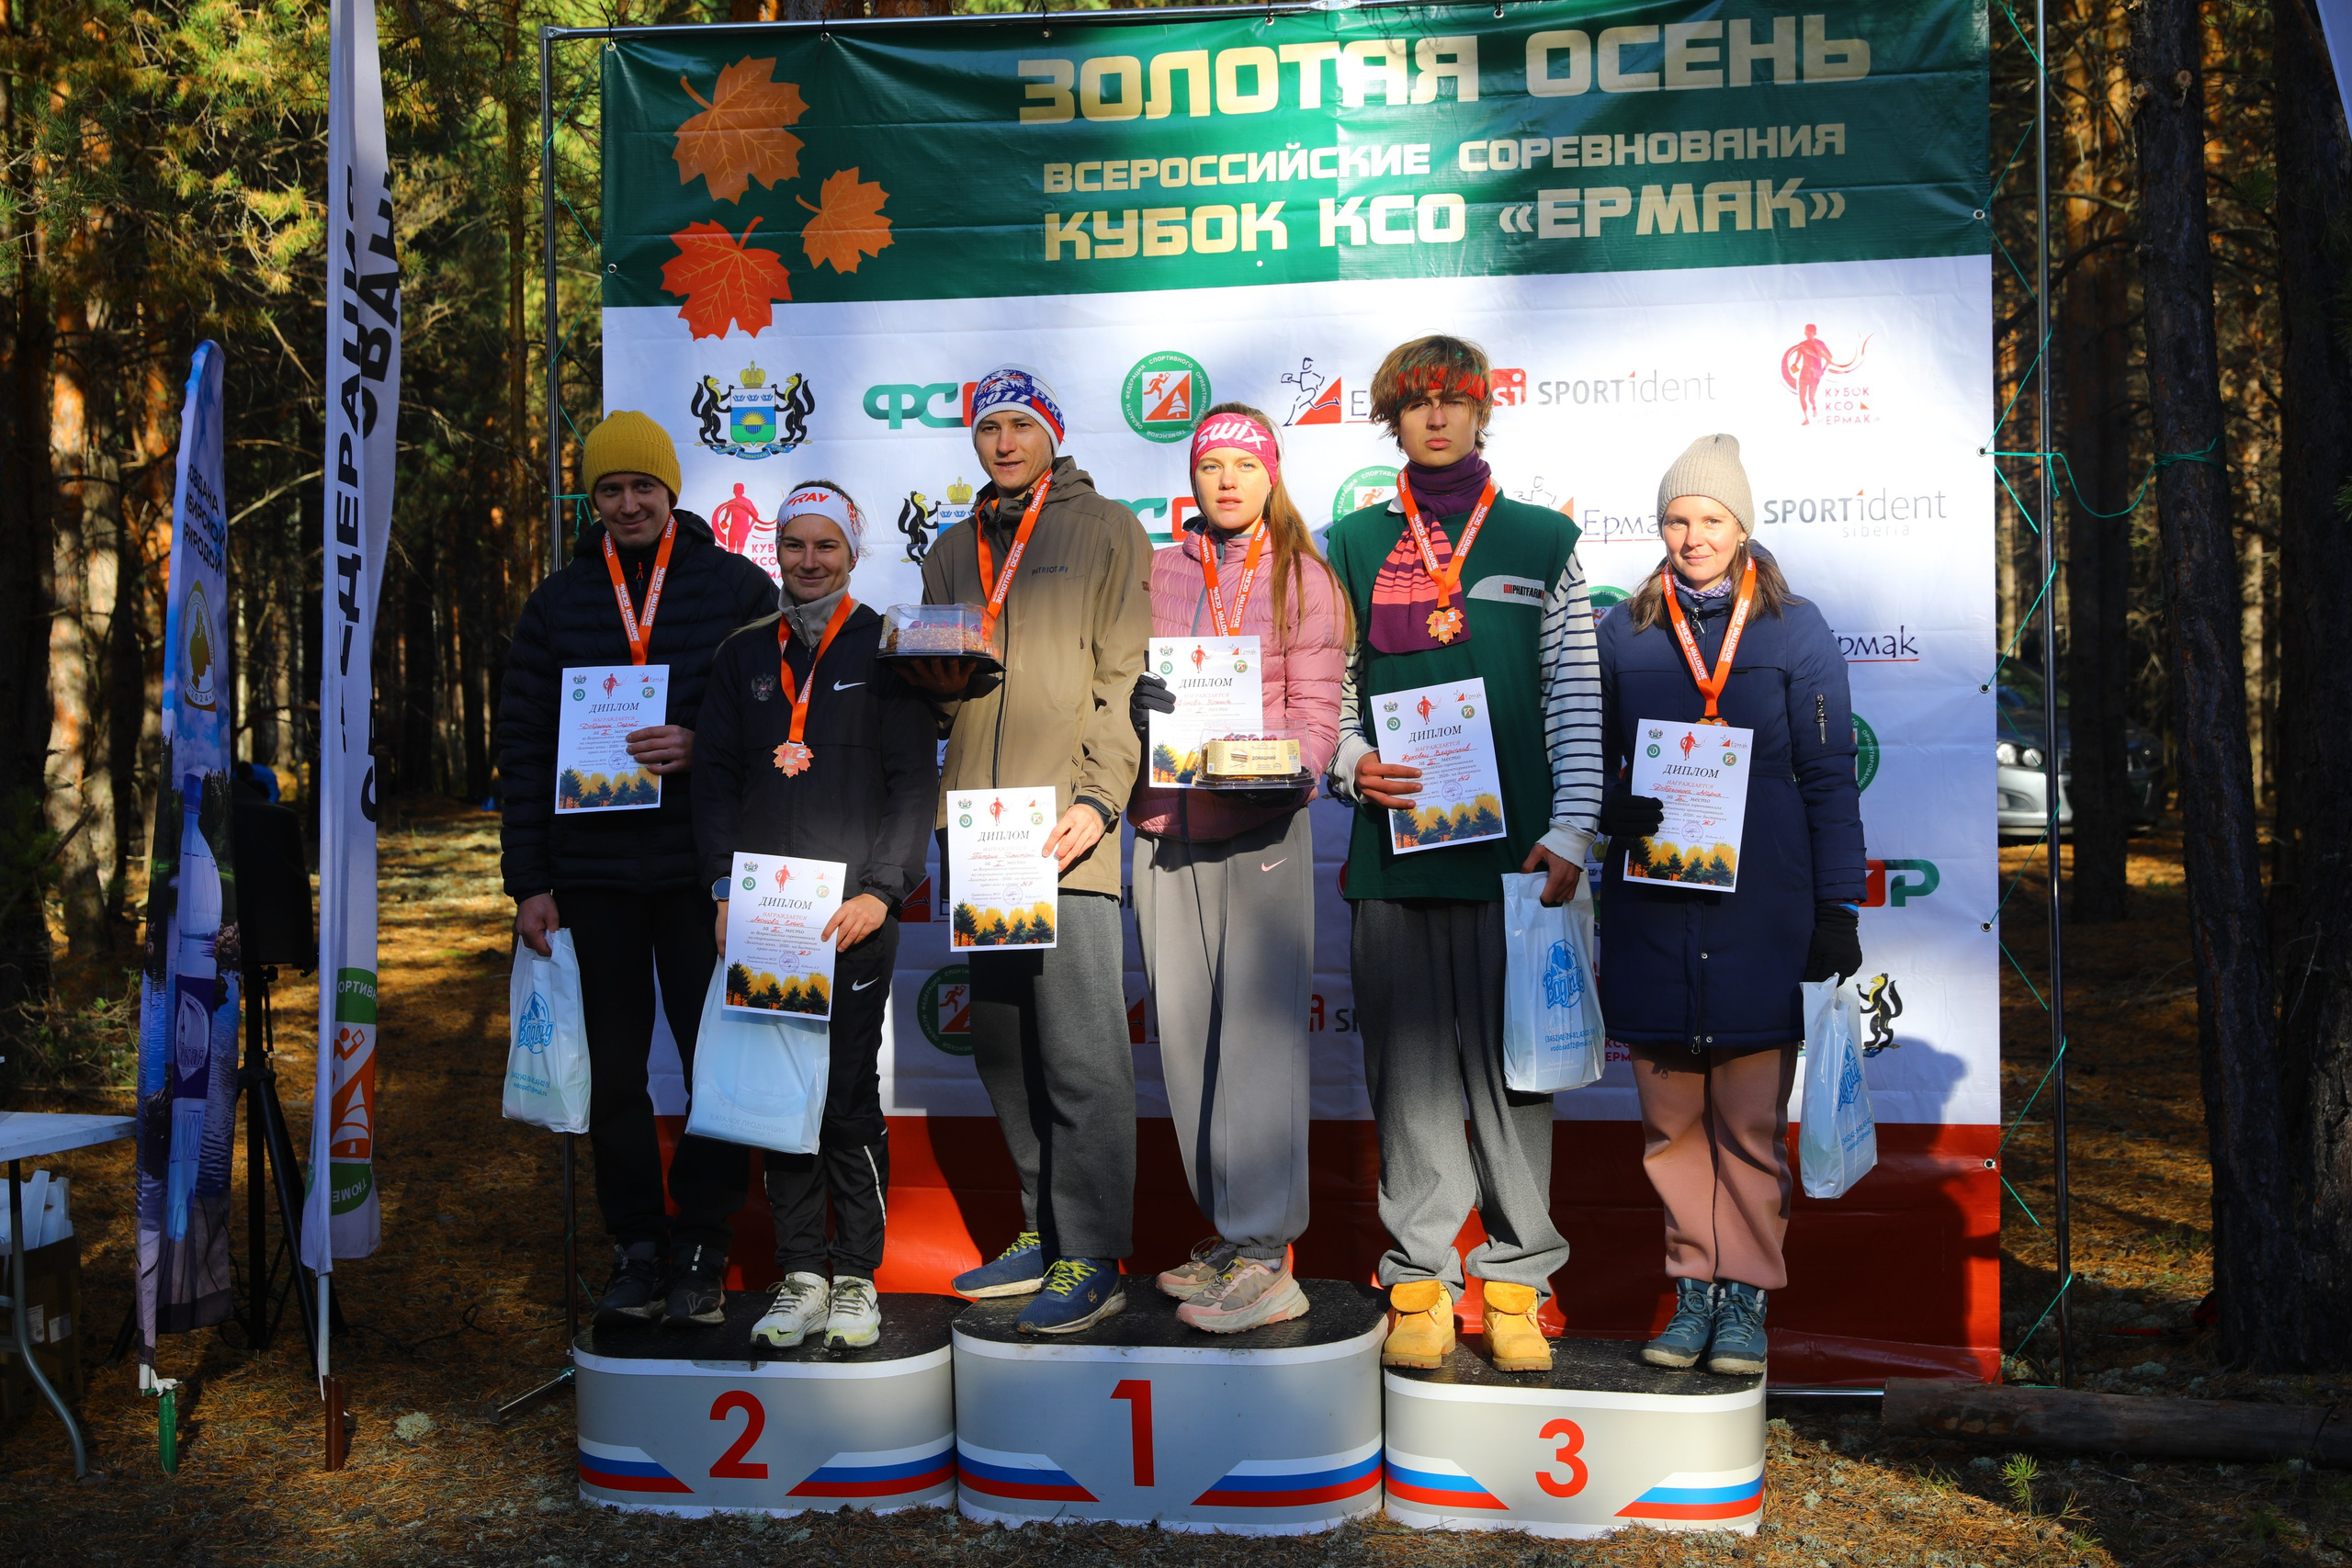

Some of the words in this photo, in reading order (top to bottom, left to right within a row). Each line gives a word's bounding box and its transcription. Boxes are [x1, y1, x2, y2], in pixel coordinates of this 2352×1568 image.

[1018, 35, 1479, 125] ЗОЛОТАЯ
[1525, 14, 1871, 97] ОСЕНЬ
[1044, 142, 1430, 193] ВСЕРОССИЙСКИЕ
[1458, 123, 1846, 172] СОРЕВНОВАНИЯ
[1045, 200, 1287, 261] КУБОК
[1318, 193, 1465, 247] КСО
[1498, 177, 1846, 240] «ЕРМАК»
[1148, 355, 1193, 368] СПОРТИВНОГО
[1125, 364, 1146, 400] ФЕДЕРАЦИЯ
[1537, 369, 1716, 406] SPORTident
[1825, 387, 1870, 398] КУБОК
[1125, 402, 1143, 430] ОБЛАСТИ
[1825, 400, 1854, 412] КСО
[1146, 430, 1186, 439] ТЮМЕНСКОЙ
[1029, 483, 1047, 513] ТЮМЕНЬ
[1338, 479, 1358, 514] ФЕДЕРАЦИЯ
[1764, 488, 1947, 525] SPORTident
[1415, 513, 1426, 537] ОСЕНЬ
[1460, 527, 1477, 557] ЗОЛОТАЯ
[1475, 506, 1487, 526] ОСЕНЬ
[1842, 524, 1910, 538] siberia
[1422, 536, 1439, 570] ЗОЛОТАЯ
[996, 569, 1013, 604] ЗОЛОТАЯ
[1010, 542, 1024, 568] ОСЕНЬ
[645, 593, 659, 626] ЗОЛОТАЯ
[655, 567, 666, 592] ОСЕНЬ
[1233, 594, 1246, 628] ЗОЛОТАЯ
[1243, 569, 1254, 592] ОСЕНЬ
[1447, 612, 1455, 622] 3
[1724, 627, 1740, 663] ЗОЛОТАЯ
[1737, 600, 1749, 626] ОСЕНЬ
[1680, 619, 1693, 646] ОСЕНЬ
[1836, 625, 1918, 659] рмак
[1690, 645, 1707, 680] ЗОЛОТАЯ
[1179, 678, 1232, 689] ДИПЛОМ
[589, 702, 639, 715] ДИПЛОМ
[1408, 725, 1463, 743] ДИПЛОМ
[1415, 740, 1460, 751] НАГРАЖДАЕТСЯ
[1662, 764, 1720, 779] ДИПЛОМ
[1667, 780, 1713, 789] НАГРАЖДАЕТСЯ
[978, 830, 1029, 842] ДИПЛОМ
[758, 897, 813, 910] ДИПЛОМ
[763, 911, 807, 920] НАГРАЖДАЕТСЯ
[708, 1390, 768, 1479] 2
[1110, 1379, 1154, 1487] 1
[1535, 1417, 1588, 1498] 3
